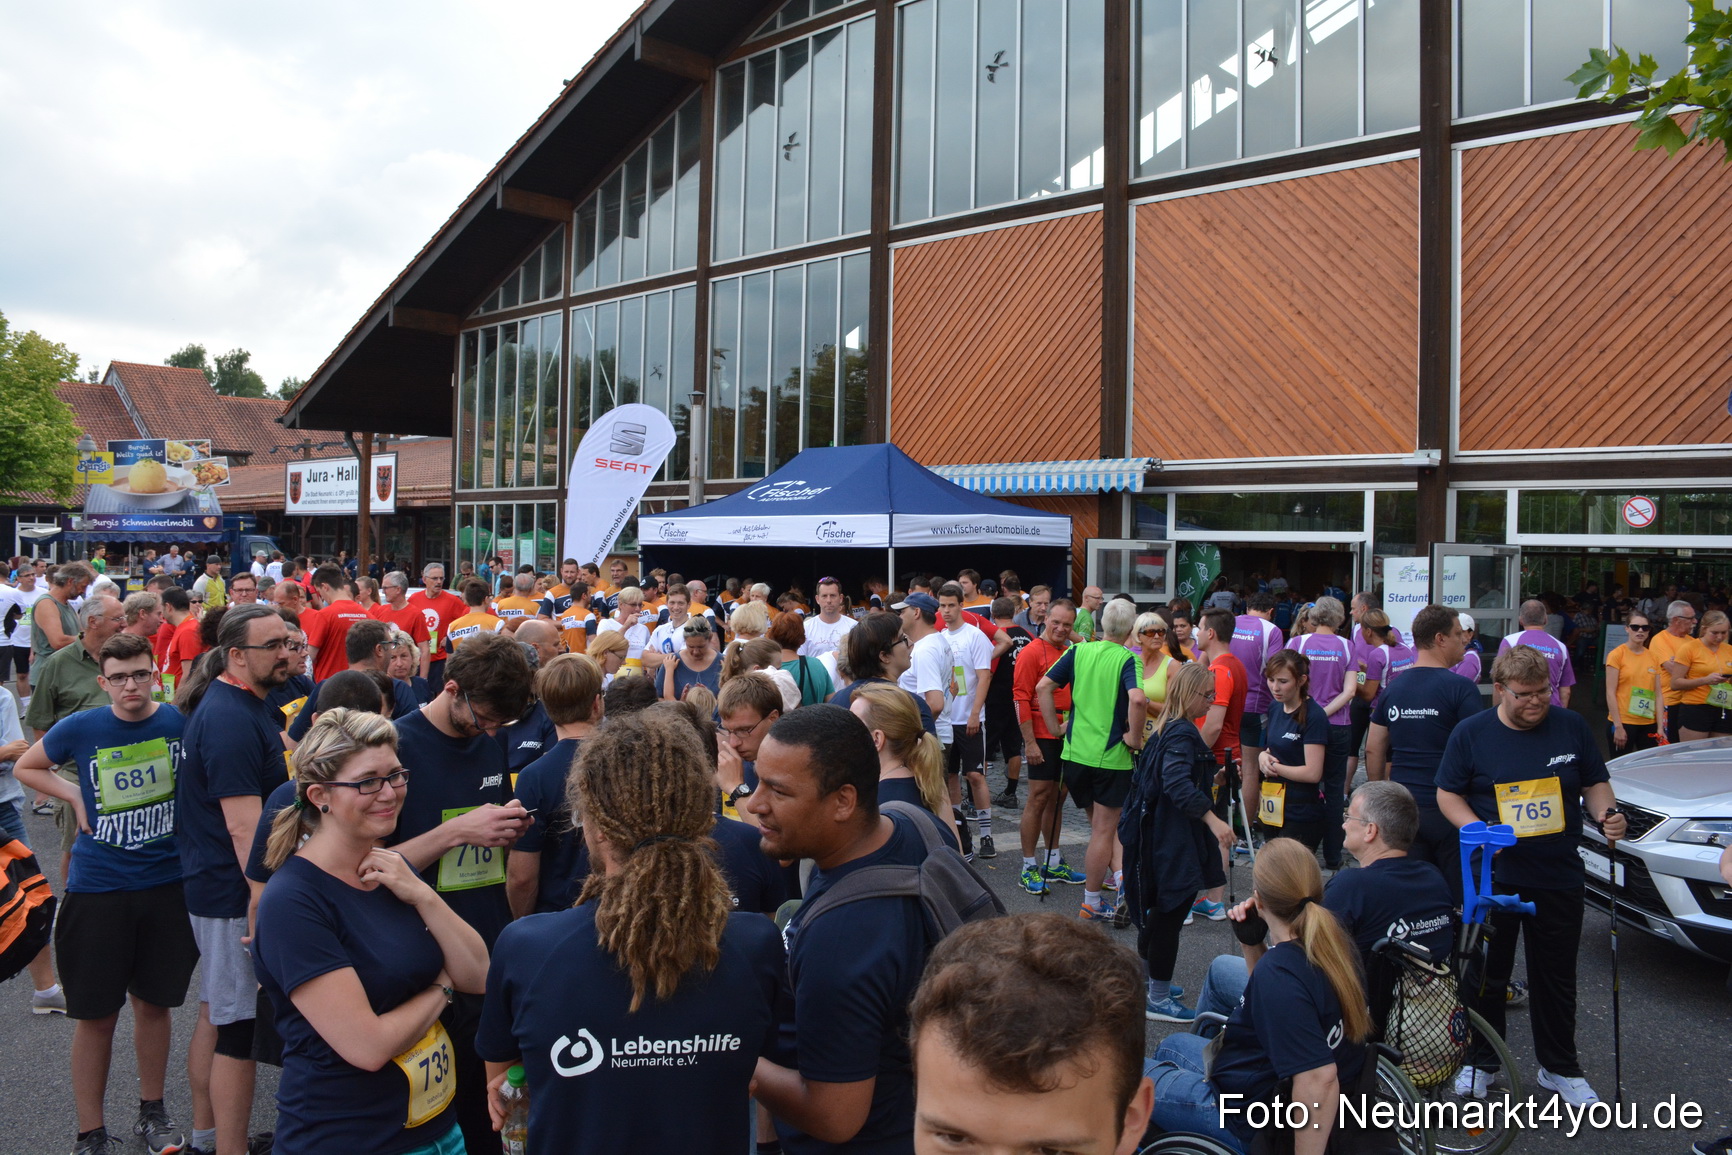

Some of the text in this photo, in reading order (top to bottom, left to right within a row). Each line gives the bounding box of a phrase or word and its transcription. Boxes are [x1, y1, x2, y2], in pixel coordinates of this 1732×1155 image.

[595, 458, 652, 474] SEAT
[307, 469, 328, 483] Jura
[337, 465, 358, 481] Hall
[759, 487, 832, 498] Fischer
[121, 517, 194, 528] Schmankerlmobil
[592, 496, 635, 564] er-automobile.de
[664, 528, 689, 537] Fischer
[822, 528, 856, 538] Fischer
[930, 523, 1041, 536] www.fischer-automobile.de
[1415, 572, 1457, 581] firmauf
[1388, 593, 1466, 605] Startuntagen
[451, 626, 478, 639] Benzin
[1716, 690, 1728, 700] 80
[1639, 699, 1650, 709] 54
[1400, 708, 1439, 716] Lebenshilfe
[113, 765, 157, 791] 681
[1511, 800, 1552, 822] 765
[1410, 914, 1450, 930] Lebenshilfe
[611, 1034, 742, 1056] Lebenshilfe
[418, 1043, 449, 1092] 735
[611, 1054, 698, 1069] Neumarkt e.V.
